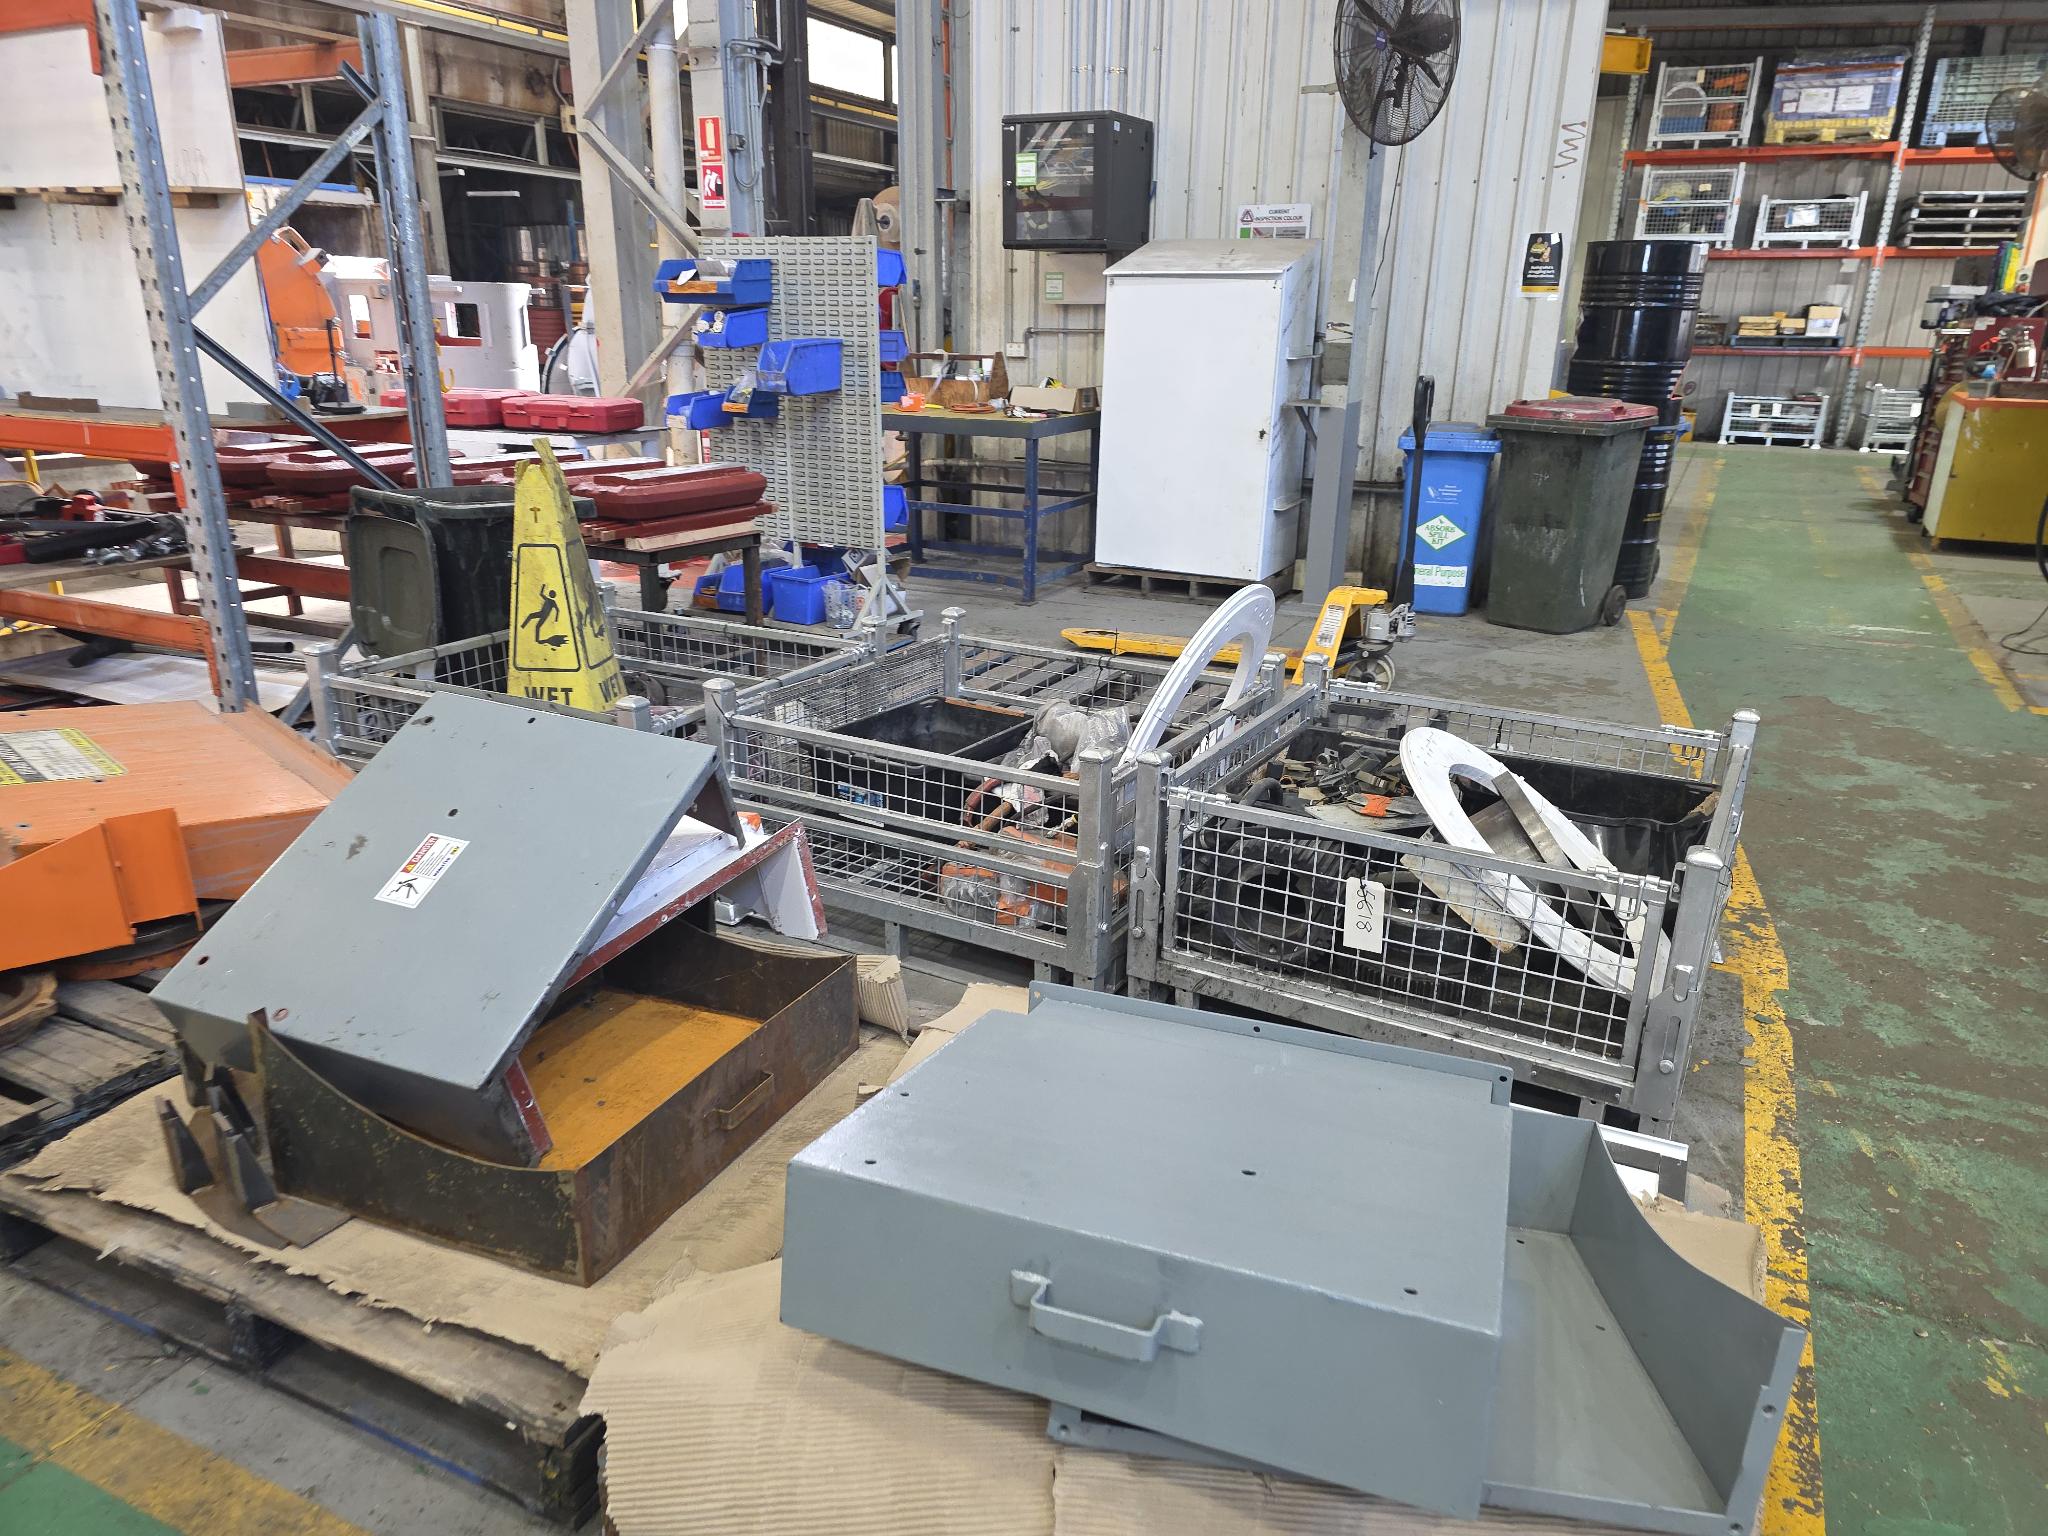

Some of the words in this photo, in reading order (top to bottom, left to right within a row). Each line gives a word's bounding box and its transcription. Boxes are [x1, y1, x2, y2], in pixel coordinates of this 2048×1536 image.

[1413, 566, 1433, 577] neral
[1434, 567, 1465, 579] Purpose
[524, 686, 573, 706] WET
[411, 837, 438, 862] DANGER
